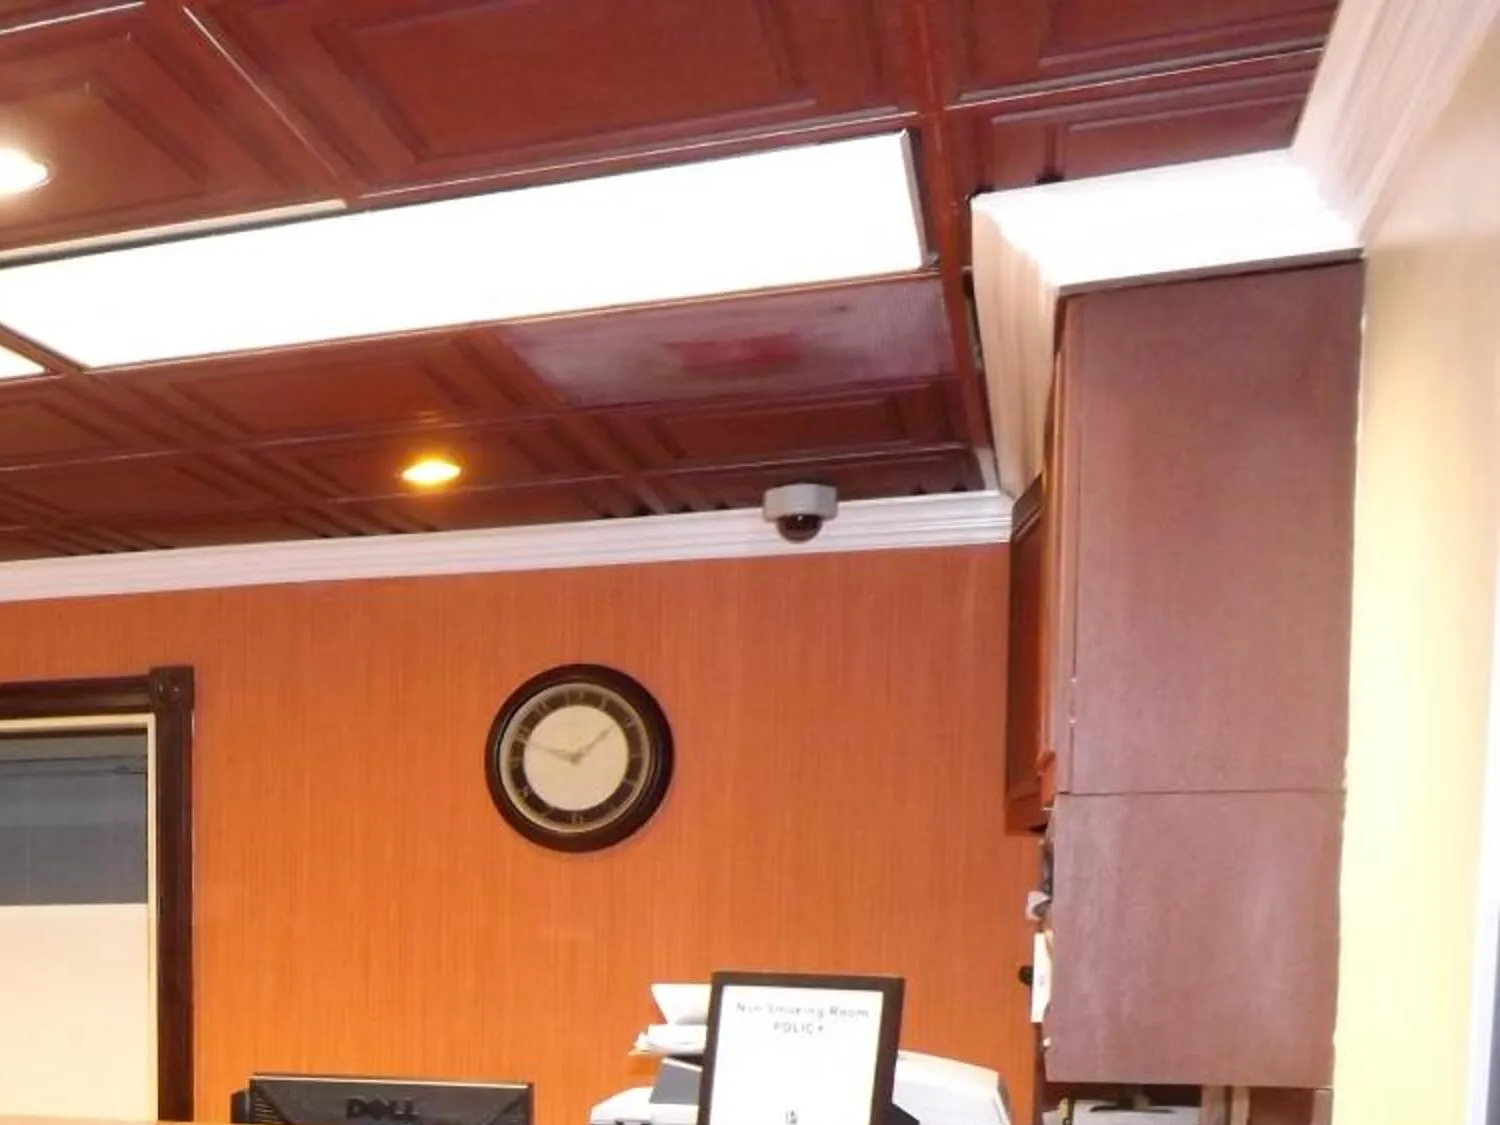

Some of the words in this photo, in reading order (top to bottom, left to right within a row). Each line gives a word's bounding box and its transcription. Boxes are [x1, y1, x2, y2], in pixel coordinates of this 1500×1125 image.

[829, 1005, 869, 1018] Room
[773, 1020, 824, 1035] POLICY
[346, 1098, 419, 1121] DELL
